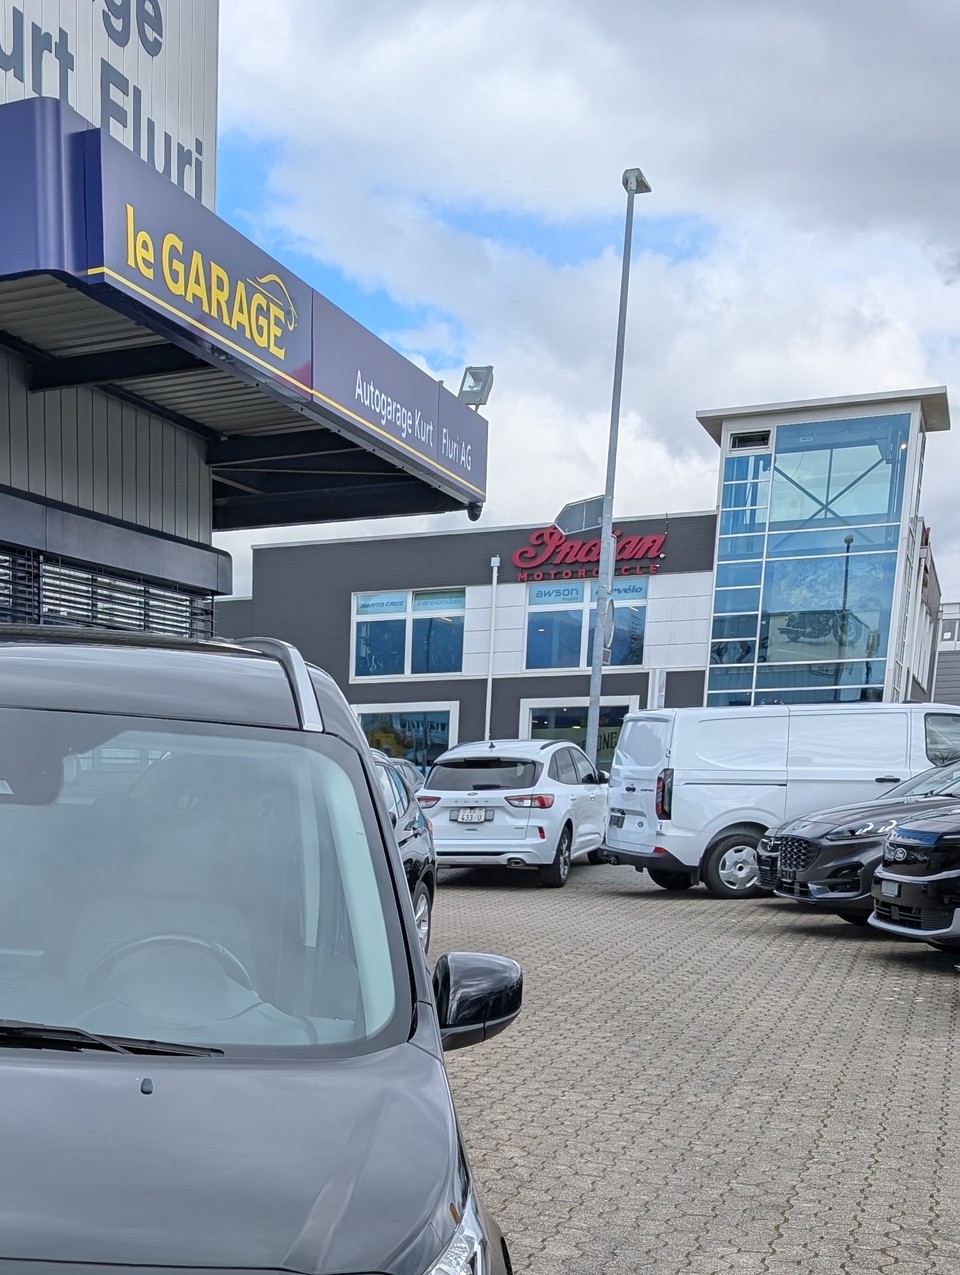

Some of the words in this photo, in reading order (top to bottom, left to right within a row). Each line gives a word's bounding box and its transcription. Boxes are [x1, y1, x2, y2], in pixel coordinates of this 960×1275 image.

[100, 57, 203, 204] Fluri
[125, 203, 154, 281] le
[161, 232, 286, 361] GARAGE
[355, 369, 413, 438] Autogarage
[414, 408, 434, 447] Kurt
[441, 427, 459, 463] Fluri
[460, 441, 472, 471] AG
[517, 563, 658, 582] MOTORCCLE
